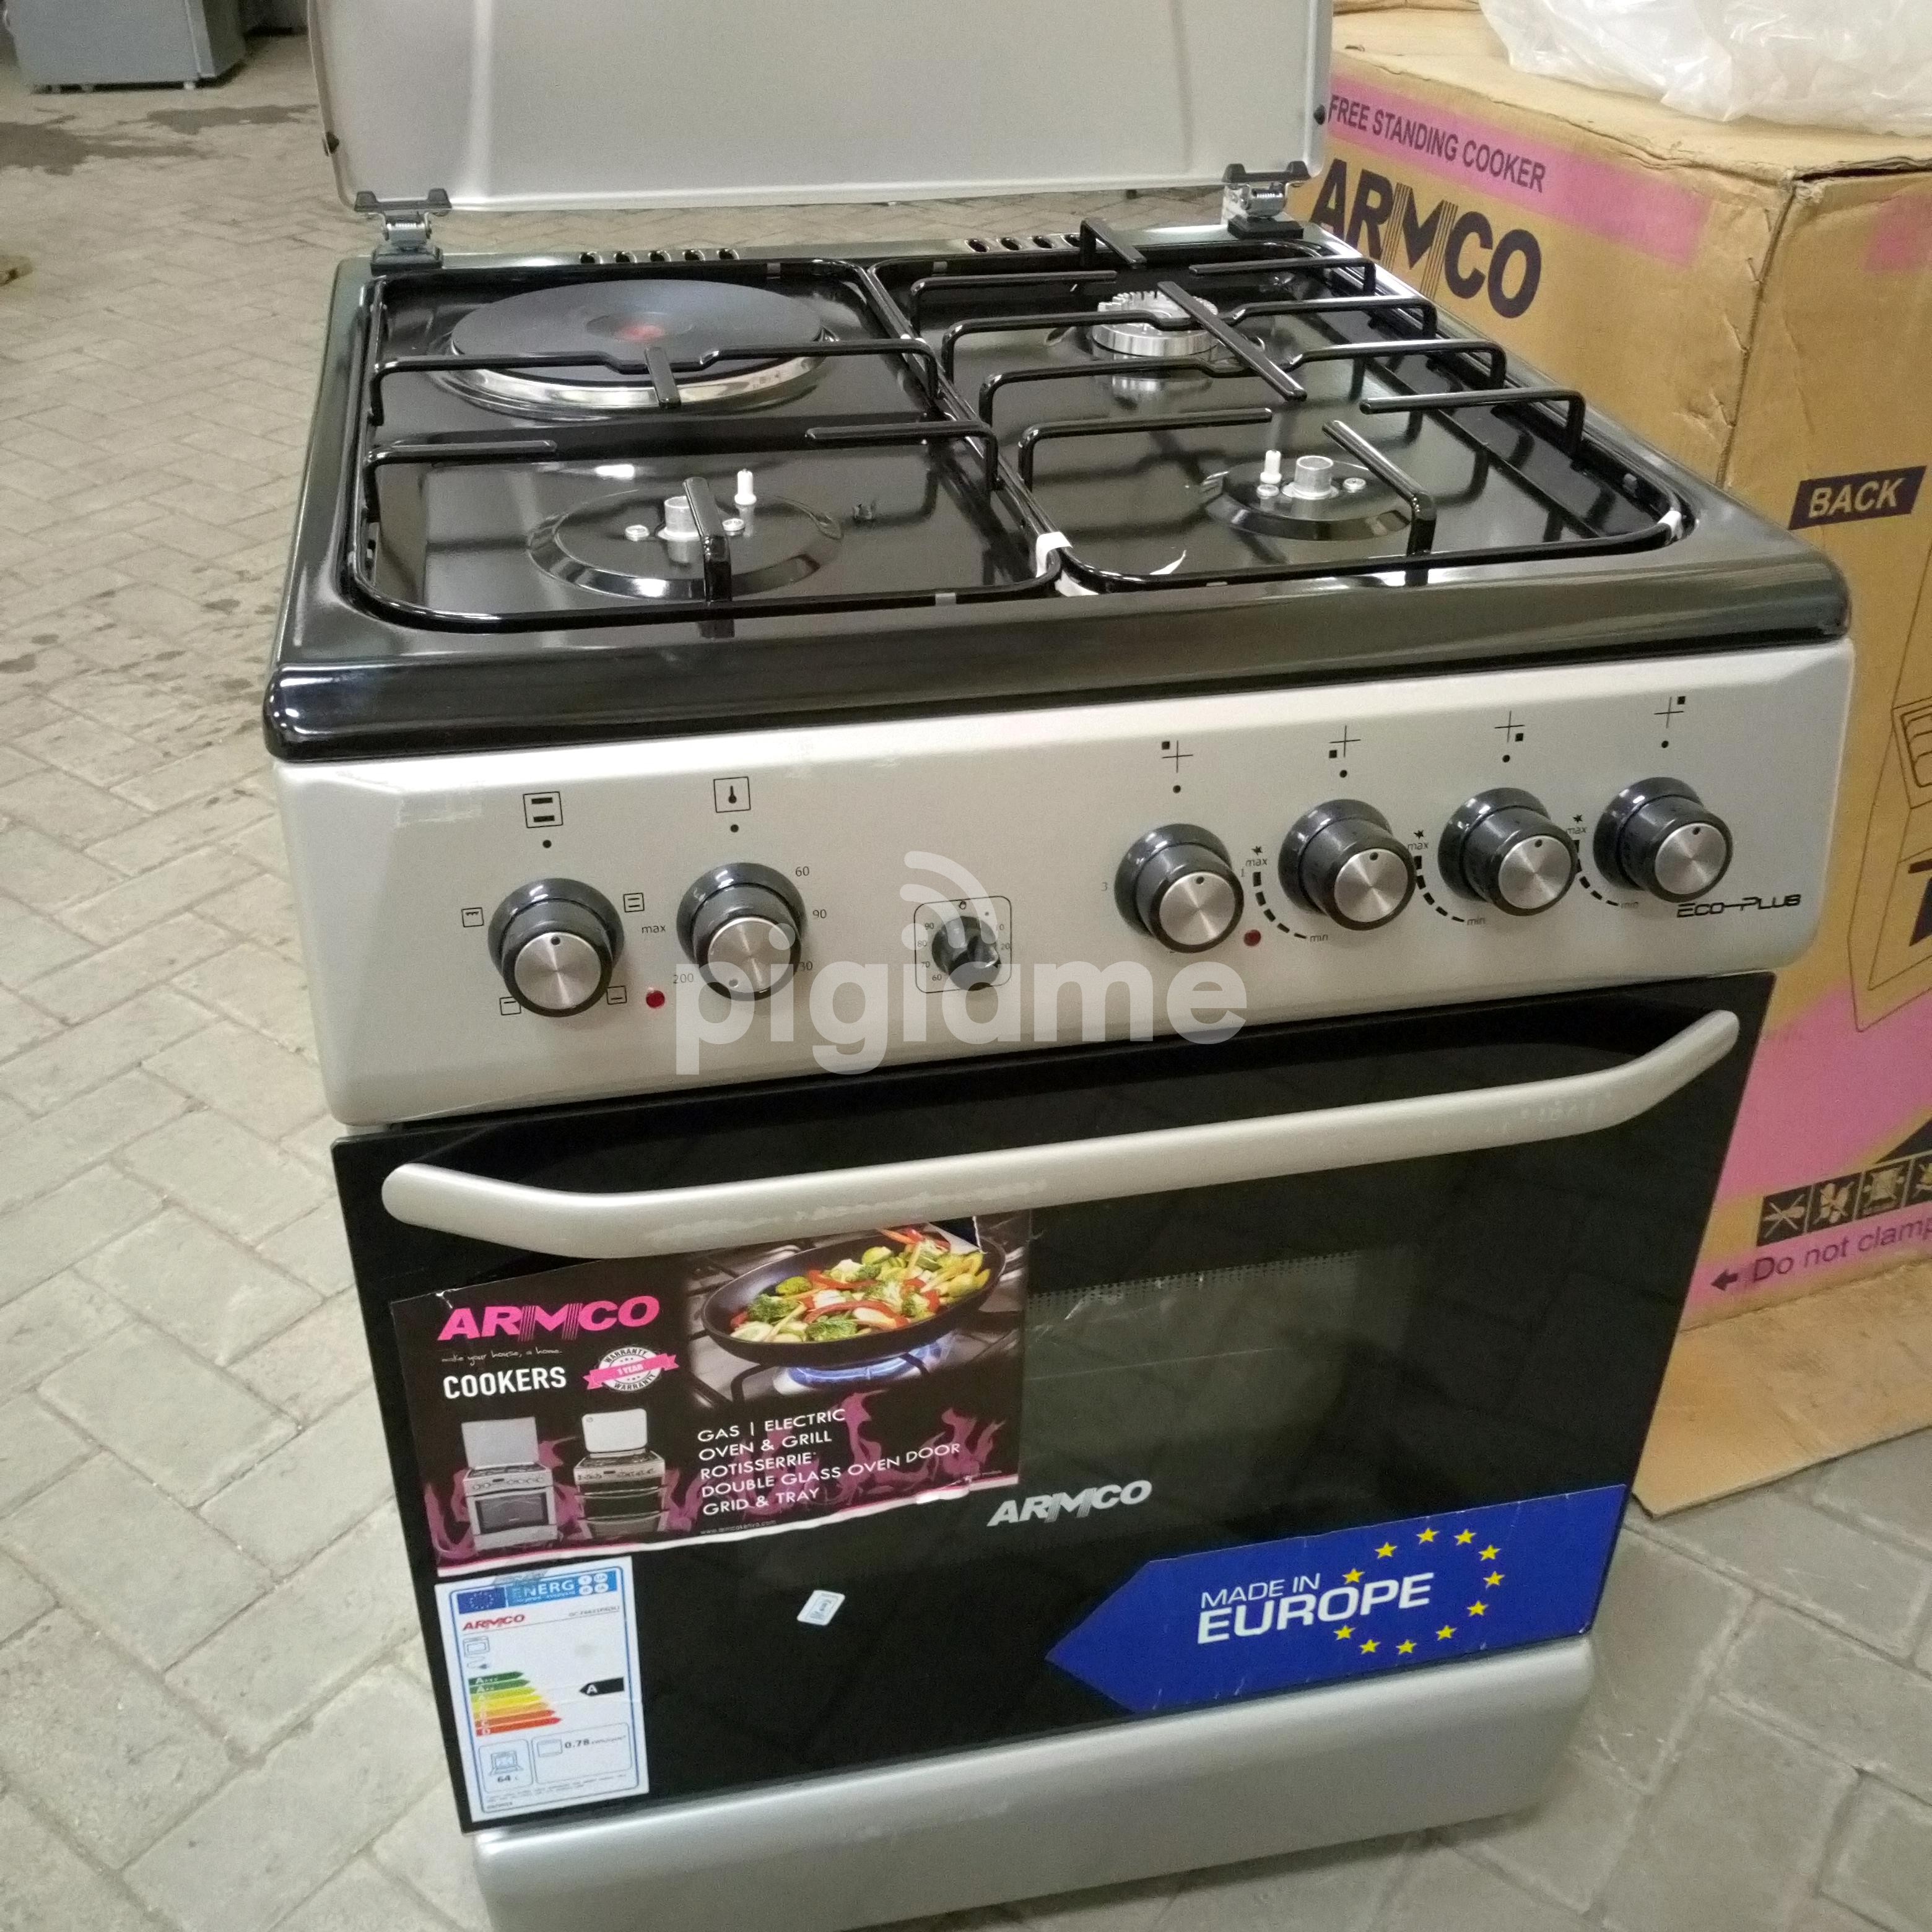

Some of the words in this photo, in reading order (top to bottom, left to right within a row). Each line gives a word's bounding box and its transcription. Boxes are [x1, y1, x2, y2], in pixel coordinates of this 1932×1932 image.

[1328, 94, 1370, 131] FREE
[1372, 109, 1458, 162] STANDING
[1462, 140, 1547, 193] COOKER
[1309, 157, 1542, 319] ARMCO
[1809, 477, 1905, 519] BACK
[1408, 842, 1429, 851] max
[795, 866, 809, 877] 60
[1245, 858, 1268, 867] max
[812, 909, 827, 919] 90
[642, 925, 666, 933] max
[673, 973, 694, 984] 200
[1752, 1257, 1793, 1283] Do
[1804, 1238, 1850, 1268] not
[437, 1295, 660, 1342] ARMCO
[604, 1348, 648, 1363] WARRANTY
[623, 1366, 644, 1374] YEAR
[443, 1367, 567, 1399] COOKERS
[614, 1373, 656, 1389] WARRANTY
[697, 1425, 740, 1442] GAS
[765, 1409, 845, 1432] ELECTRIC
[698, 1442, 754, 1461] OVEN
[761, 1439, 774, 1451] &
[781, 1430, 832, 1448] GRILL
[702, 1476, 774, 1497] DOUBLE
[781, 1467, 841, 1485] GLASS
[848, 1456, 900, 1476] OVEN
[906, 1443, 960, 1463] DOOR
[703, 1499, 749, 1515] GRID
[756, 1495, 769, 1507] &
[776, 1487, 819, 1503] TRAY
[986, 1480, 1152, 1527] ARMCO
[1201, 1580, 1285, 1609] MADE
[1292, 1573, 1320, 1593] IN
[463, 1614, 525, 1631] ARMCO
[1198, 1573, 1434, 1644] EUROPE
[565, 1738, 590, 1749] 0.78
